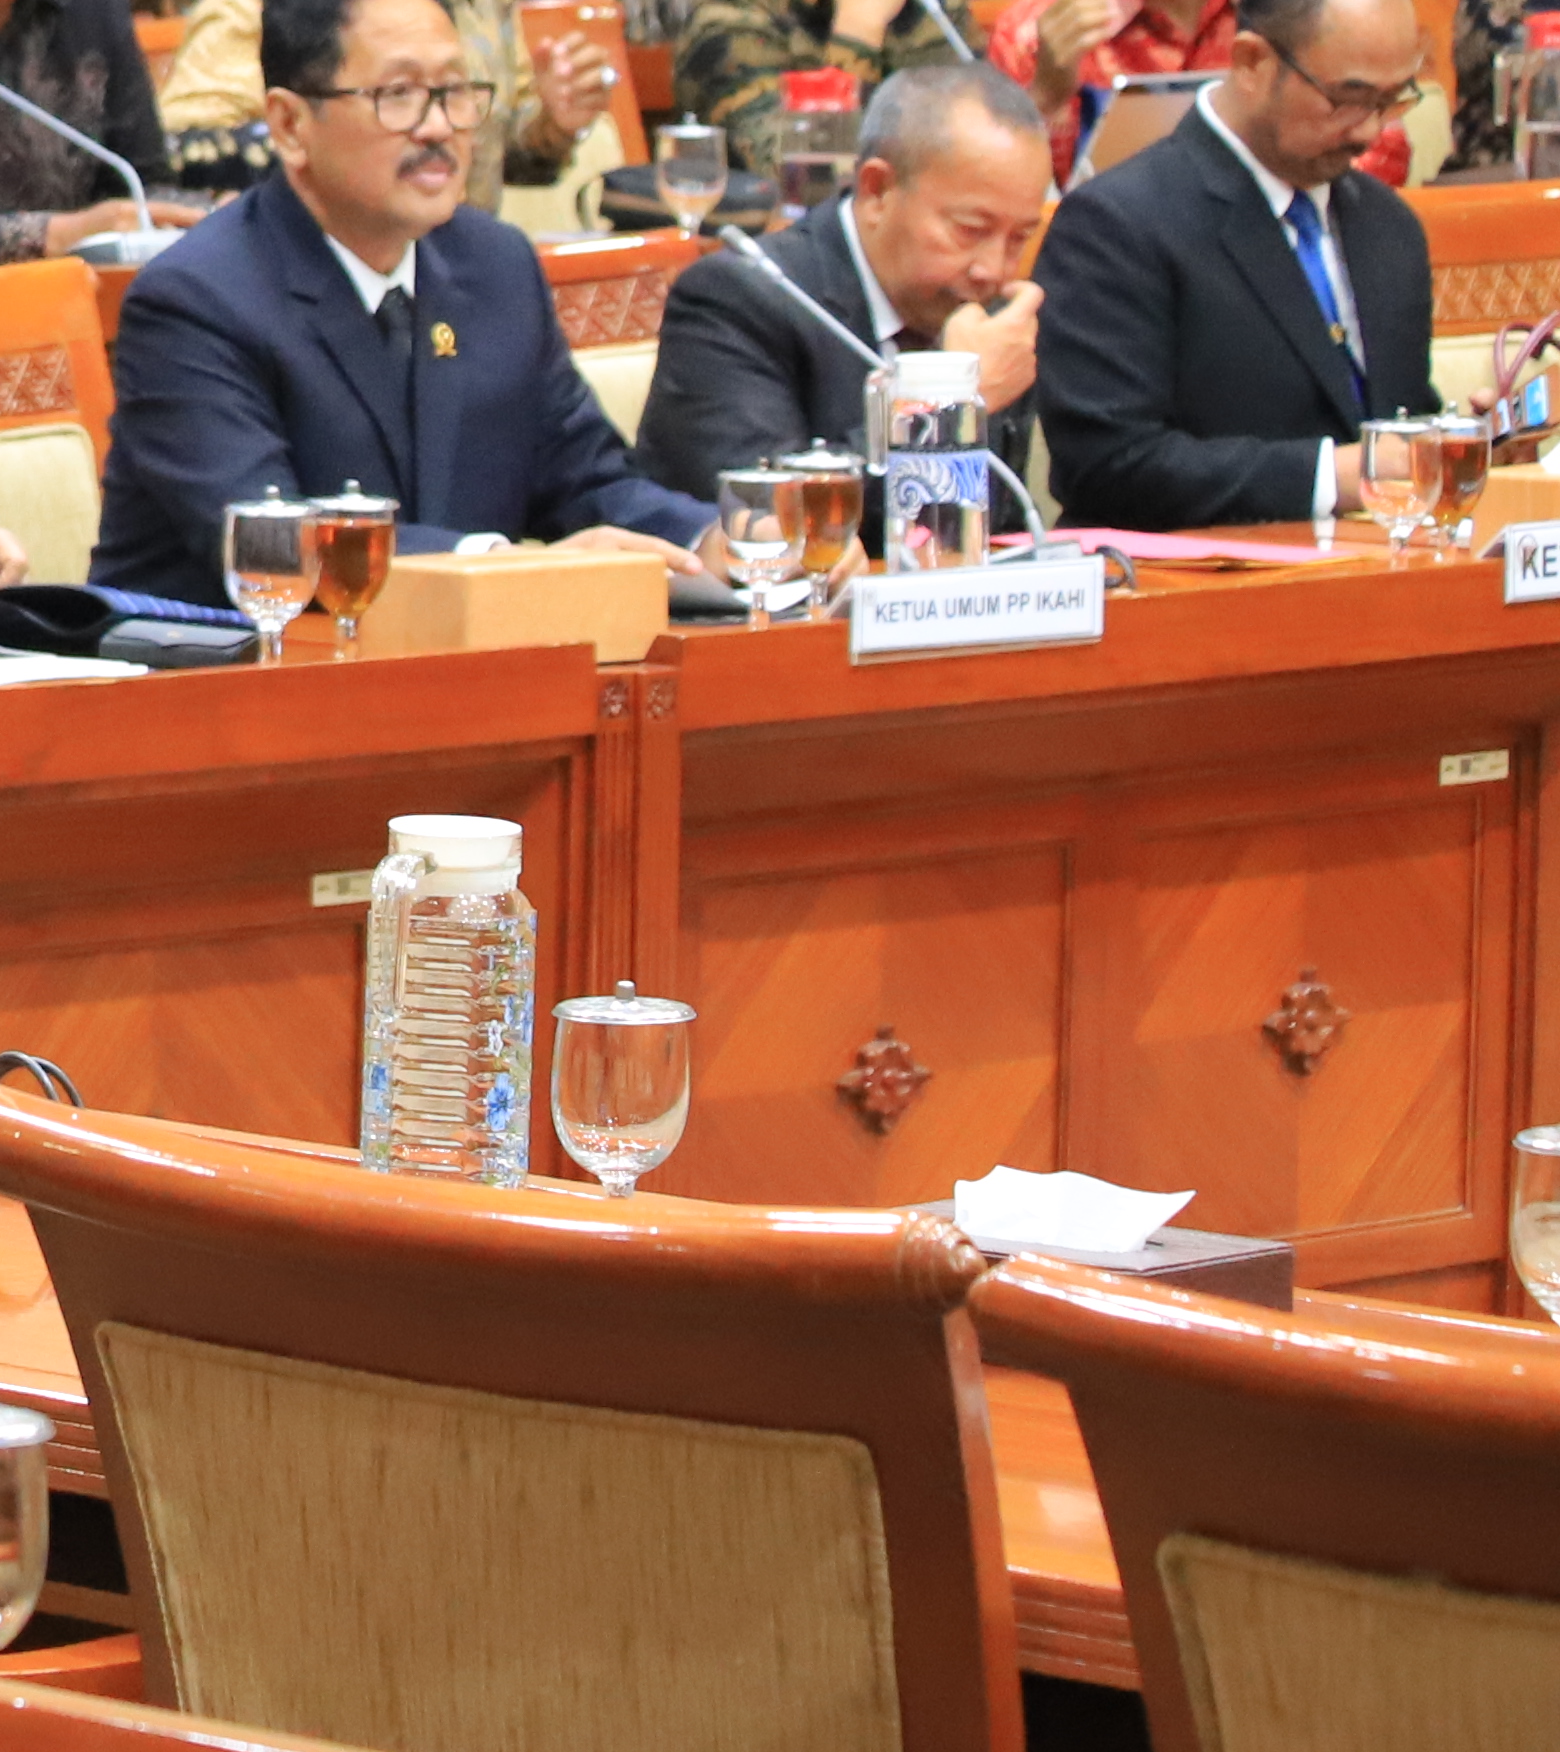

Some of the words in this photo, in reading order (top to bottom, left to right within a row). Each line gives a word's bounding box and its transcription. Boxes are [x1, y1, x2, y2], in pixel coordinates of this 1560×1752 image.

[1522, 544, 1560, 580] KE
[875, 600, 938, 624] KETUA
[945, 594, 1001, 619] UMUM
[1007, 592, 1031, 614] PP
[1036, 588, 1086, 612] IKAHI
